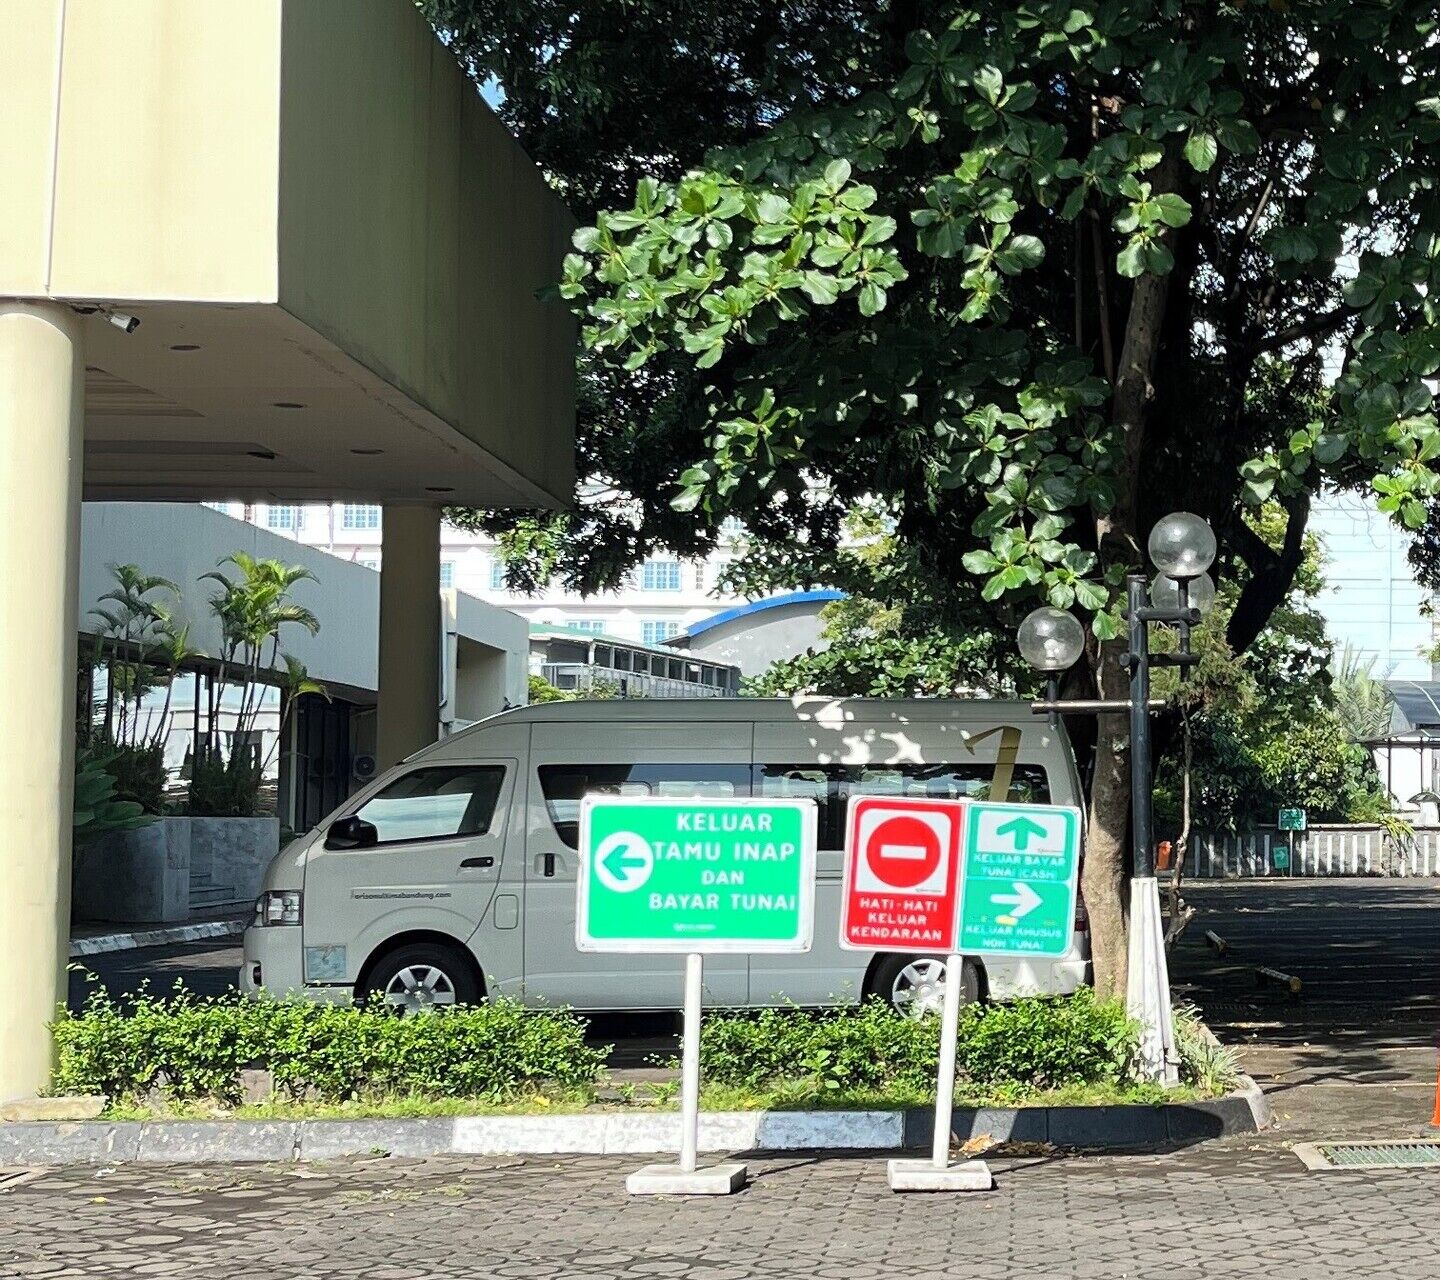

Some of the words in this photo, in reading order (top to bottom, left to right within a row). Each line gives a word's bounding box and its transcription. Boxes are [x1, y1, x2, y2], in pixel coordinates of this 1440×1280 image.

[677, 812, 773, 832] KELUAR
[652, 841, 721, 861] TAMU
[734, 842, 795, 862] INAP
[702, 869, 745, 886] DAN
[648, 892, 720, 910] BAYAR
[730, 893, 795, 911] TUNAI
[868, 911, 928, 926] KELUAR
[851, 925, 942, 940] KENDARAAN
